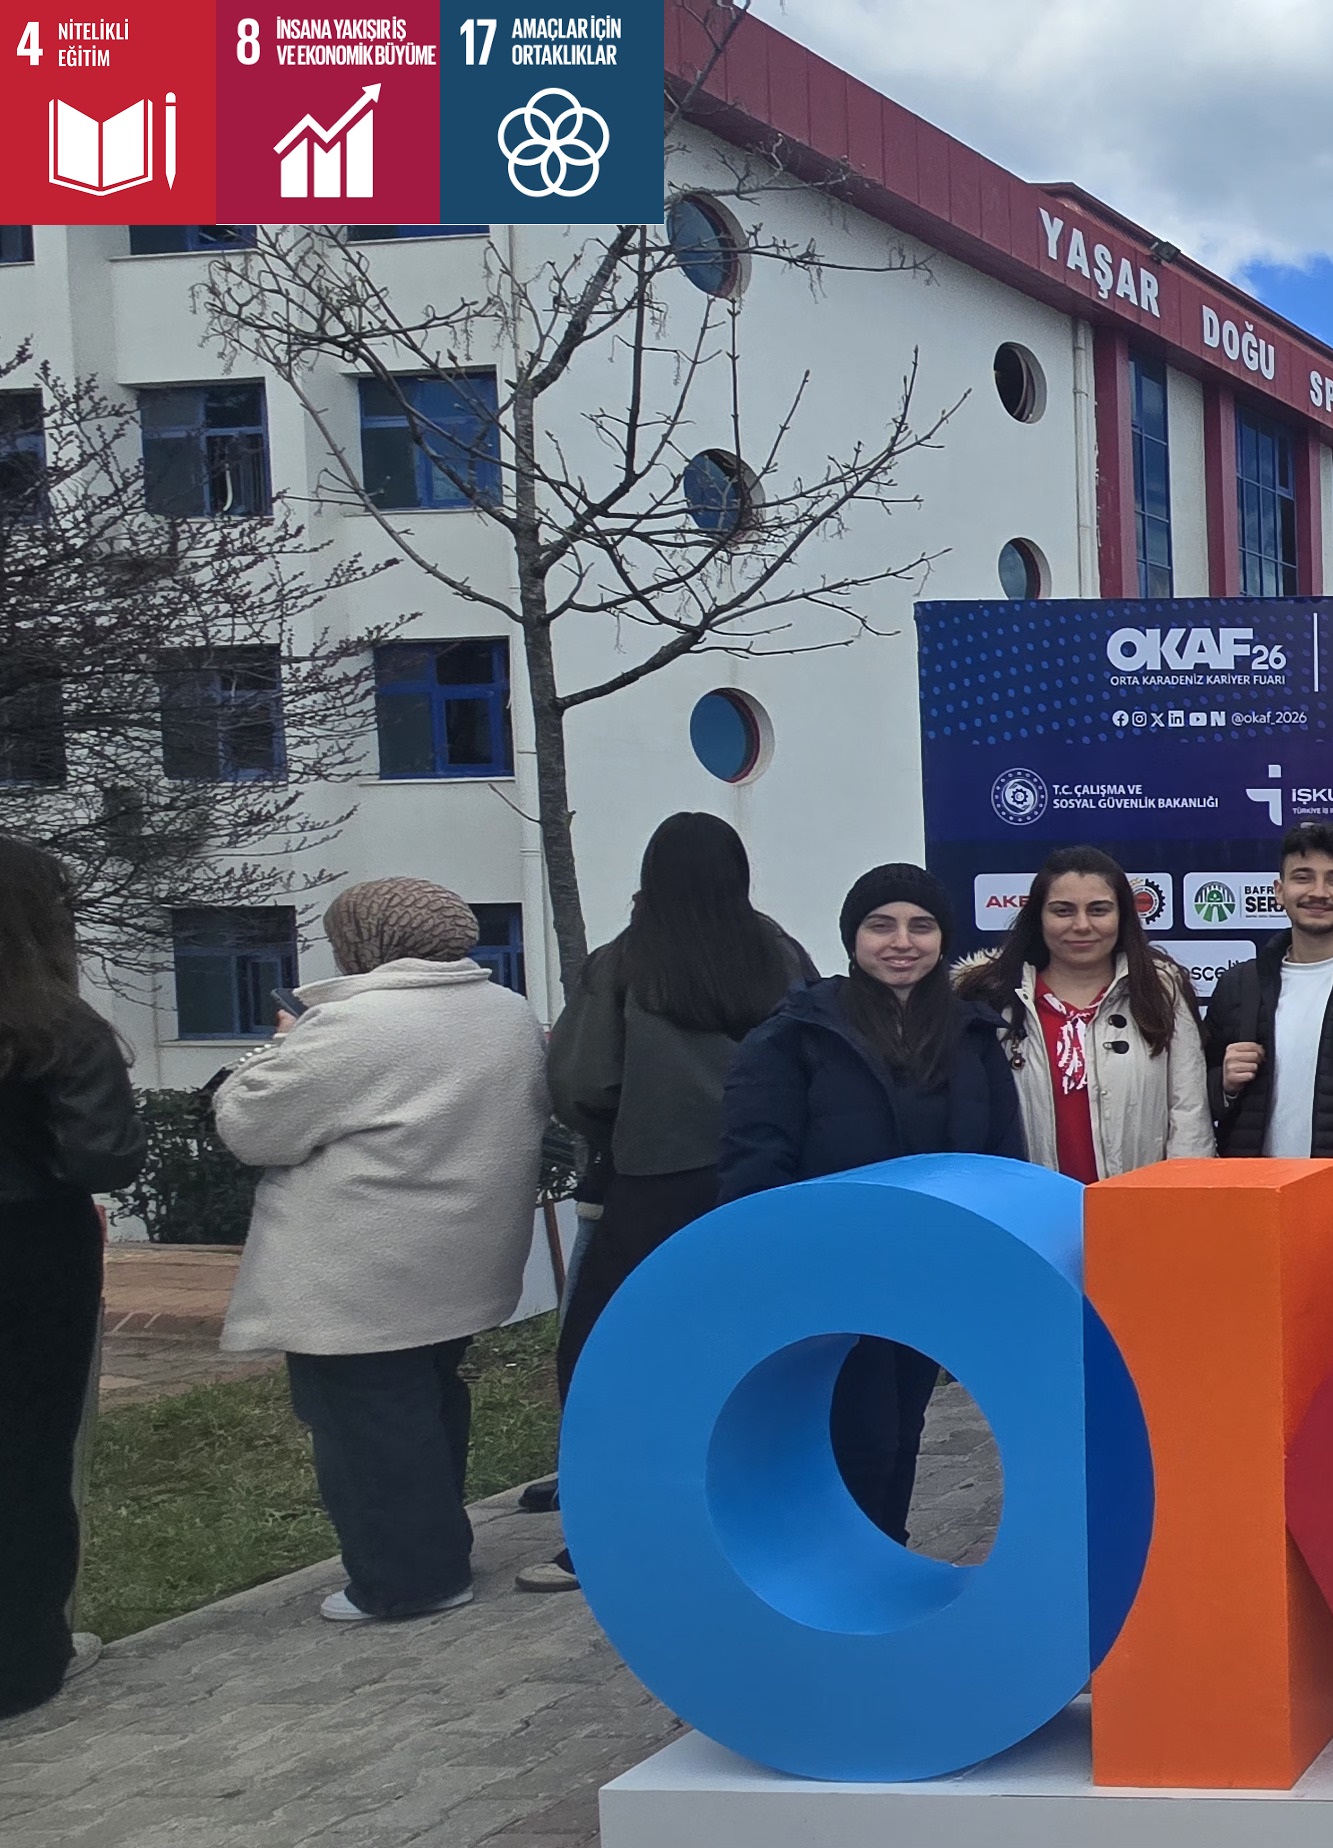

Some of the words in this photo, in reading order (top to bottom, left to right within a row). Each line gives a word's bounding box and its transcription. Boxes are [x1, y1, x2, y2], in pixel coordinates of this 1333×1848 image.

[1038, 207, 1161, 318] YAŞAR
[1203, 304, 1276, 381] DOĞU
[1110, 675, 1140, 686] ORTA
[1142, 673, 1203, 686] KARADENİZ
[1206, 673, 1250, 685] KARİYER
[1253, 675, 1285, 685] FUARI
[1231, 710, 1307, 726] @okaf_2026
[1053, 785, 1072, 795] T.C.
[1074, 784, 1126, 798] ÇALIŞMA
[1127, 784, 1143, 795] VE
[1053, 798, 1096, 809] SOSYAL
[1098, 796, 1157, 809] GÜVENLİK
[1159, 795, 1219, 808] BAKANLIĞI
